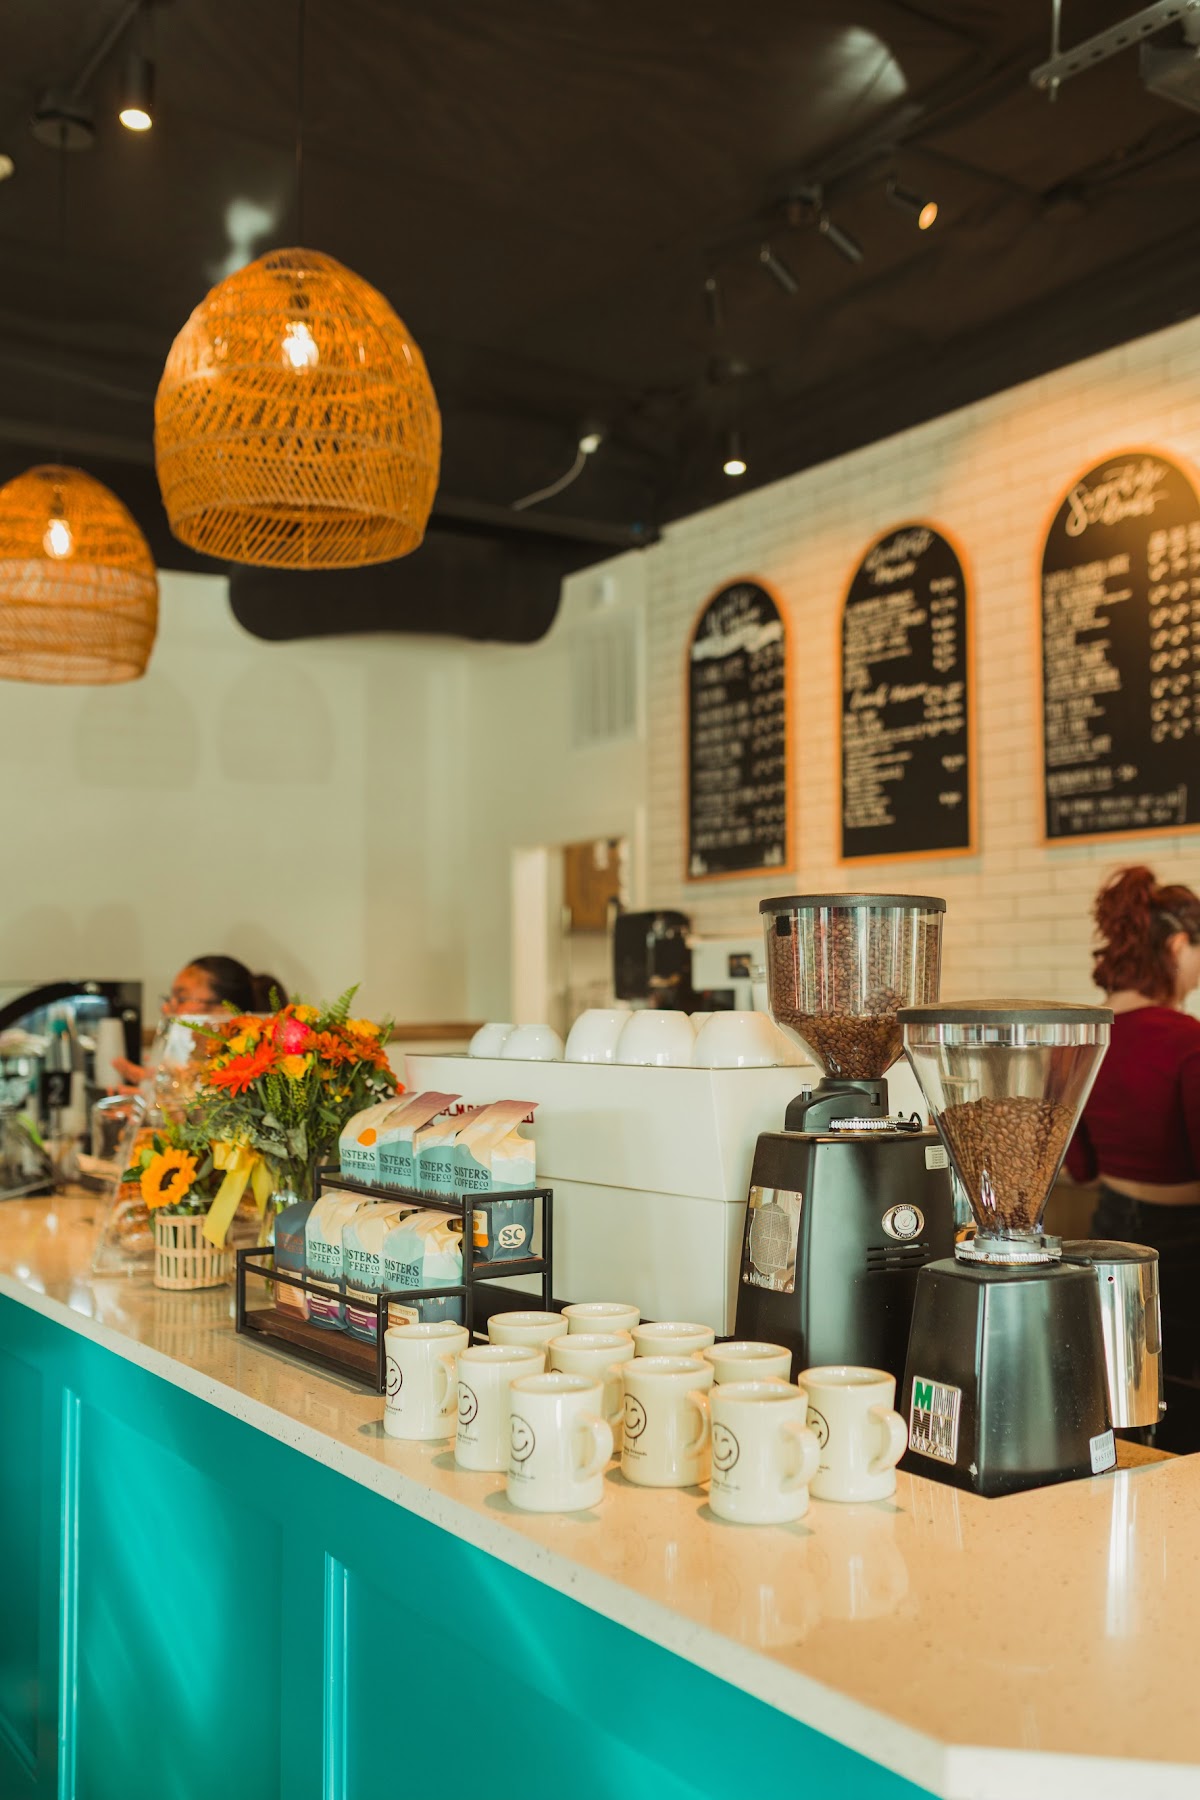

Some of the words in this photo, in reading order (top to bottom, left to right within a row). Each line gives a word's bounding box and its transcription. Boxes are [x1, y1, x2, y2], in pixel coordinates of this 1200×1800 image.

[420, 1160, 451, 1173] SISTERS
[454, 1166, 488, 1180] SISTERS
[455, 1177, 478, 1190] COFFEE
[502, 1228, 522, 1241] SC
[310, 1252, 331, 1264] FFEE
[385, 1259, 419, 1276] SISTERS
[385, 1270, 409, 1286] COFFEE
[914, 1381, 933, 1411] M
